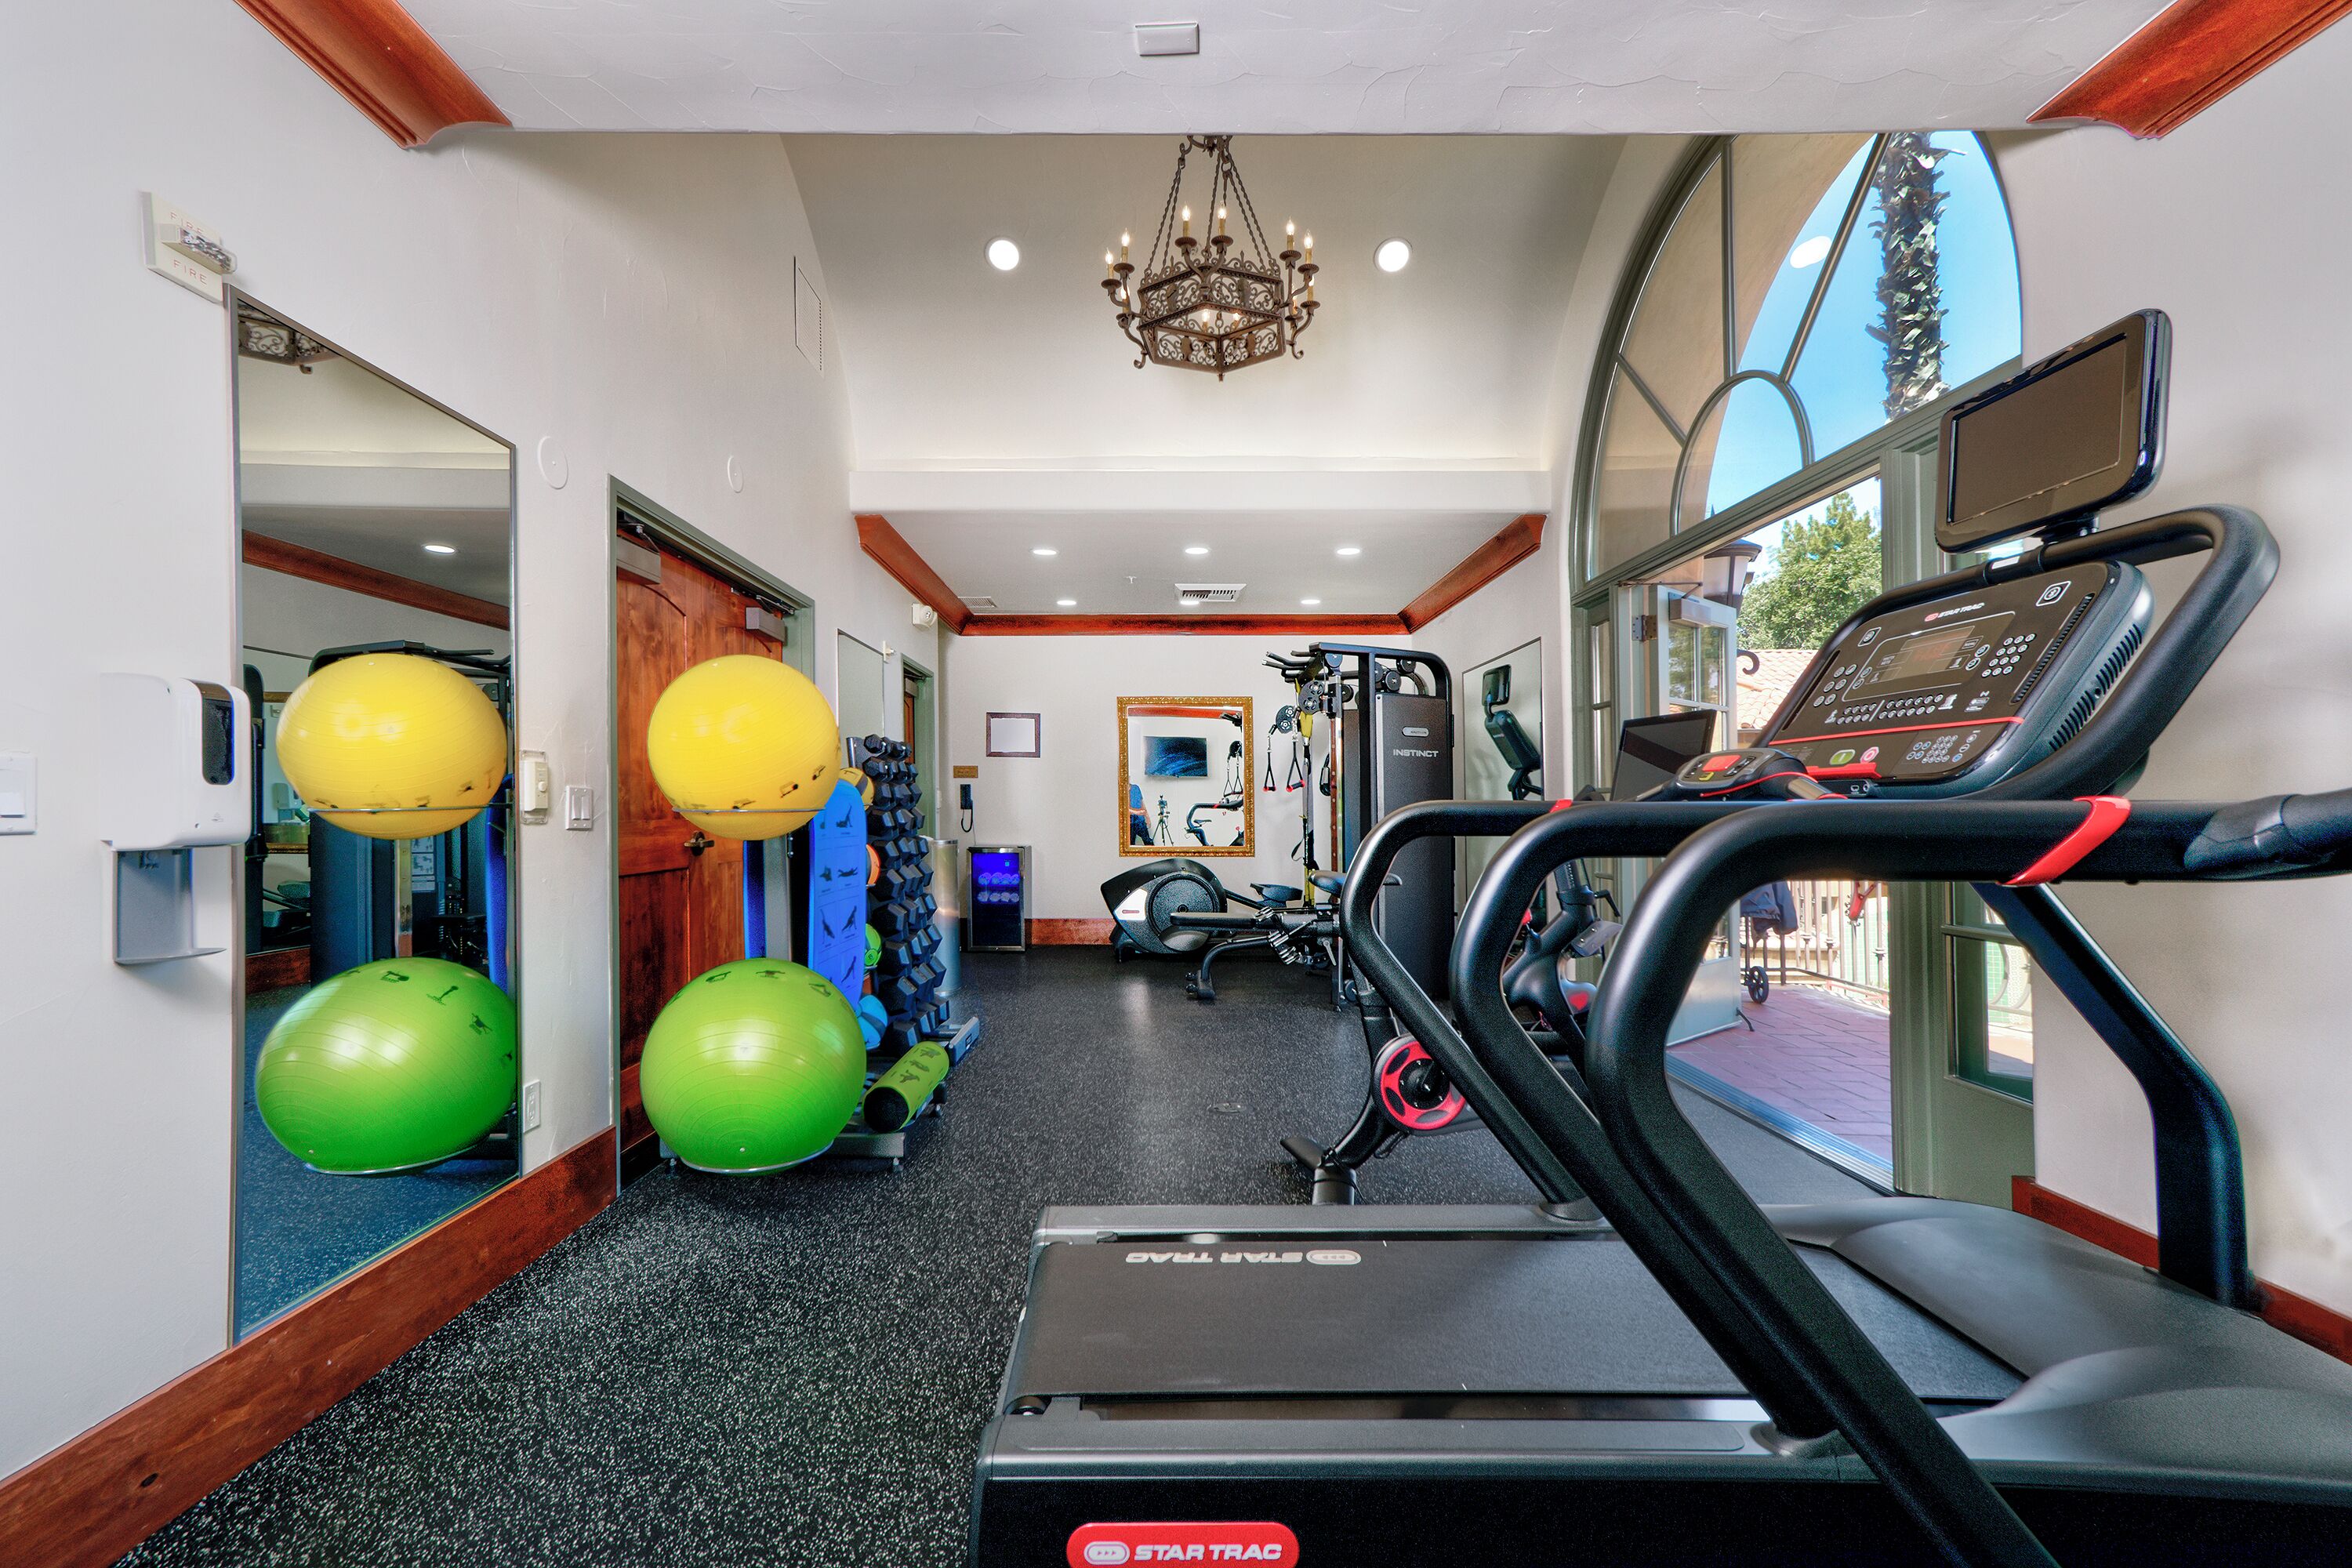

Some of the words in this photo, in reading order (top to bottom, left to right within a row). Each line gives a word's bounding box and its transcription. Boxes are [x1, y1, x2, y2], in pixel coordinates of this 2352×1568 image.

[173, 259, 208, 285] FIRE
[1937, 608, 1961, 619] STAR
[1959, 601, 1986, 613] TRAC
[1392, 748, 1439, 758] INSTINCT
[1125, 1251, 1214, 1263] TRAC
[1220, 1251, 1303, 1263] STAR
[1134, 1544, 1206, 1561] STAR
[1209, 1543, 1283, 1561] TRAC
